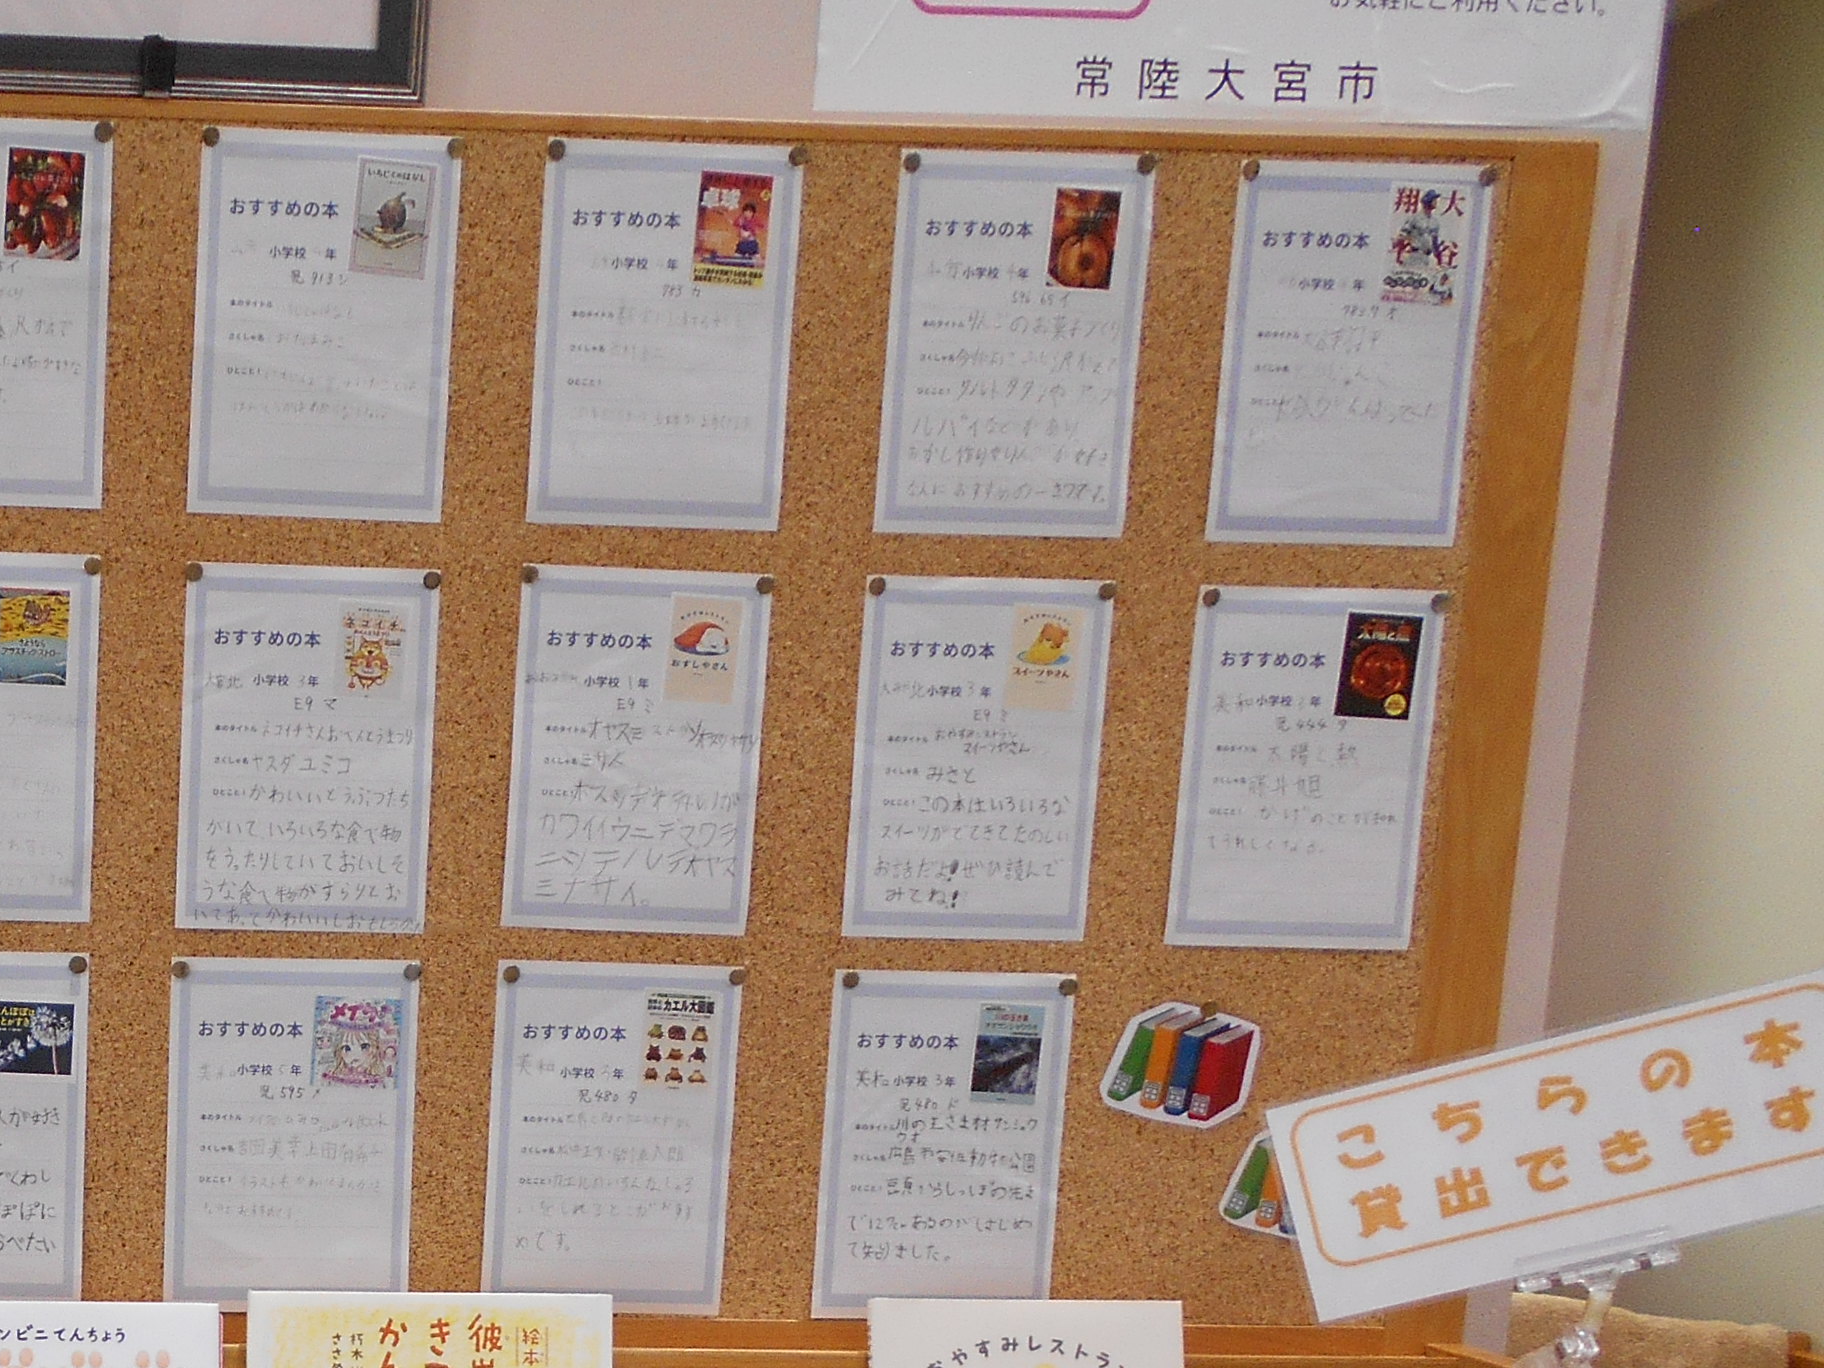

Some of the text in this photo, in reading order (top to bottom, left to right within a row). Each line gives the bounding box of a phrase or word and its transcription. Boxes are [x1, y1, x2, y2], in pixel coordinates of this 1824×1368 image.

[1075, 55, 1379, 103] 常陸大宮市
[229, 198, 340, 220] おすすめの本
[571, 208, 682, 230] おすすめの本
[924, 217, 1034, 240] おすすめの本
[1262, 230, 1370, 250] おすすめの本
[214, 629, 321, 648] おすすめの本
[546, 630, 653, 650] おすすめの本
[889, 640, 996, 660] おすすめの本
[1220, 650, 1326, 669] おすすめの本
[253, 675, 289, 686] 小学校
[584, 676, 619, 688] 小学校
[926, 766, 977, 784] みさと
[198, 1021, 304, 1040] おすすめの本
[523, 1024, 627, 1042] おすすめの本
[857, 1033, 959, 1052] おすすめの本
[1337, 1019, 1803, 1169] こちらの本
[1350, 1086, 1815, 1238] 貸出できます
[522, 1328, 541, 1366] 絵本
